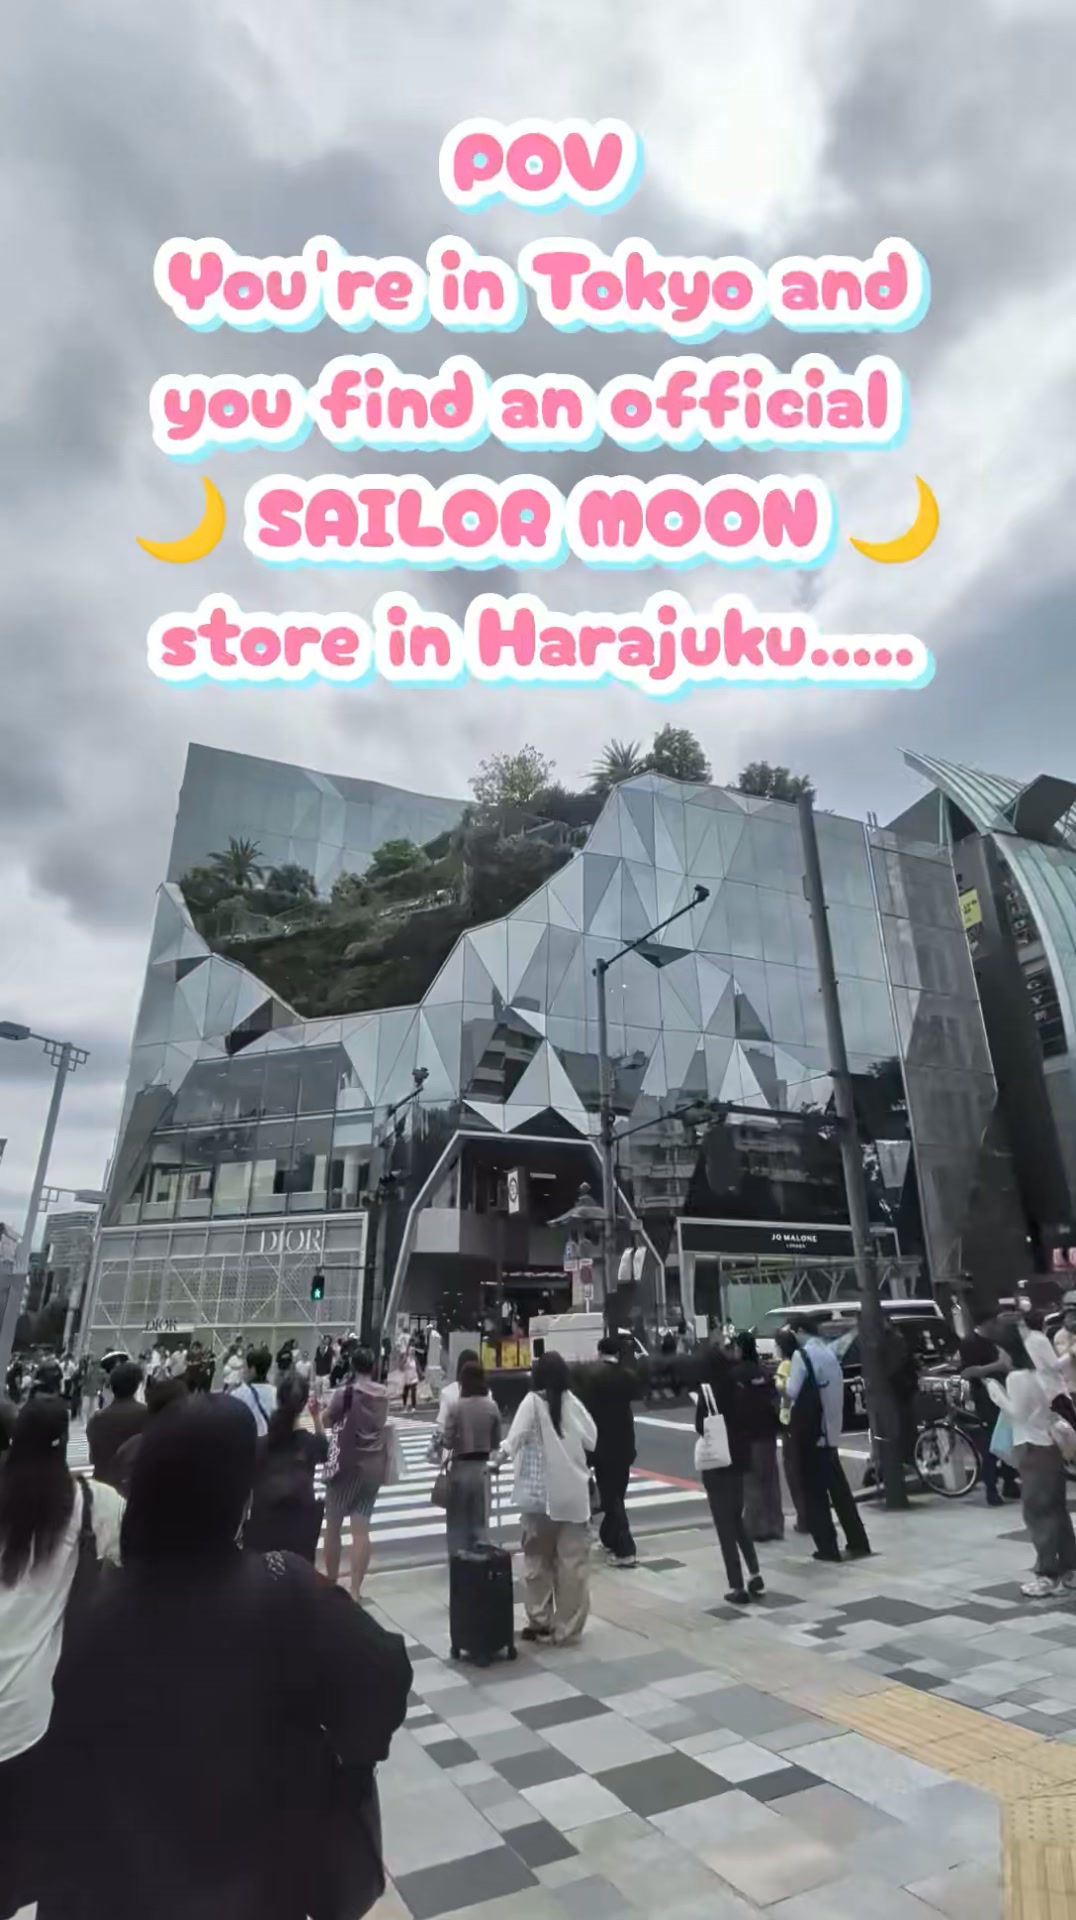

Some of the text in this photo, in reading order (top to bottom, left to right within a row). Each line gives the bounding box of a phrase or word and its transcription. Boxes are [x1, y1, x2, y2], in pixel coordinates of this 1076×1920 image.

[260, 1229, 321, 1253] DIOR
[771, 1233, 818, 1243] JO MALONE
[145, 1318, 178, 1331] DIOR
